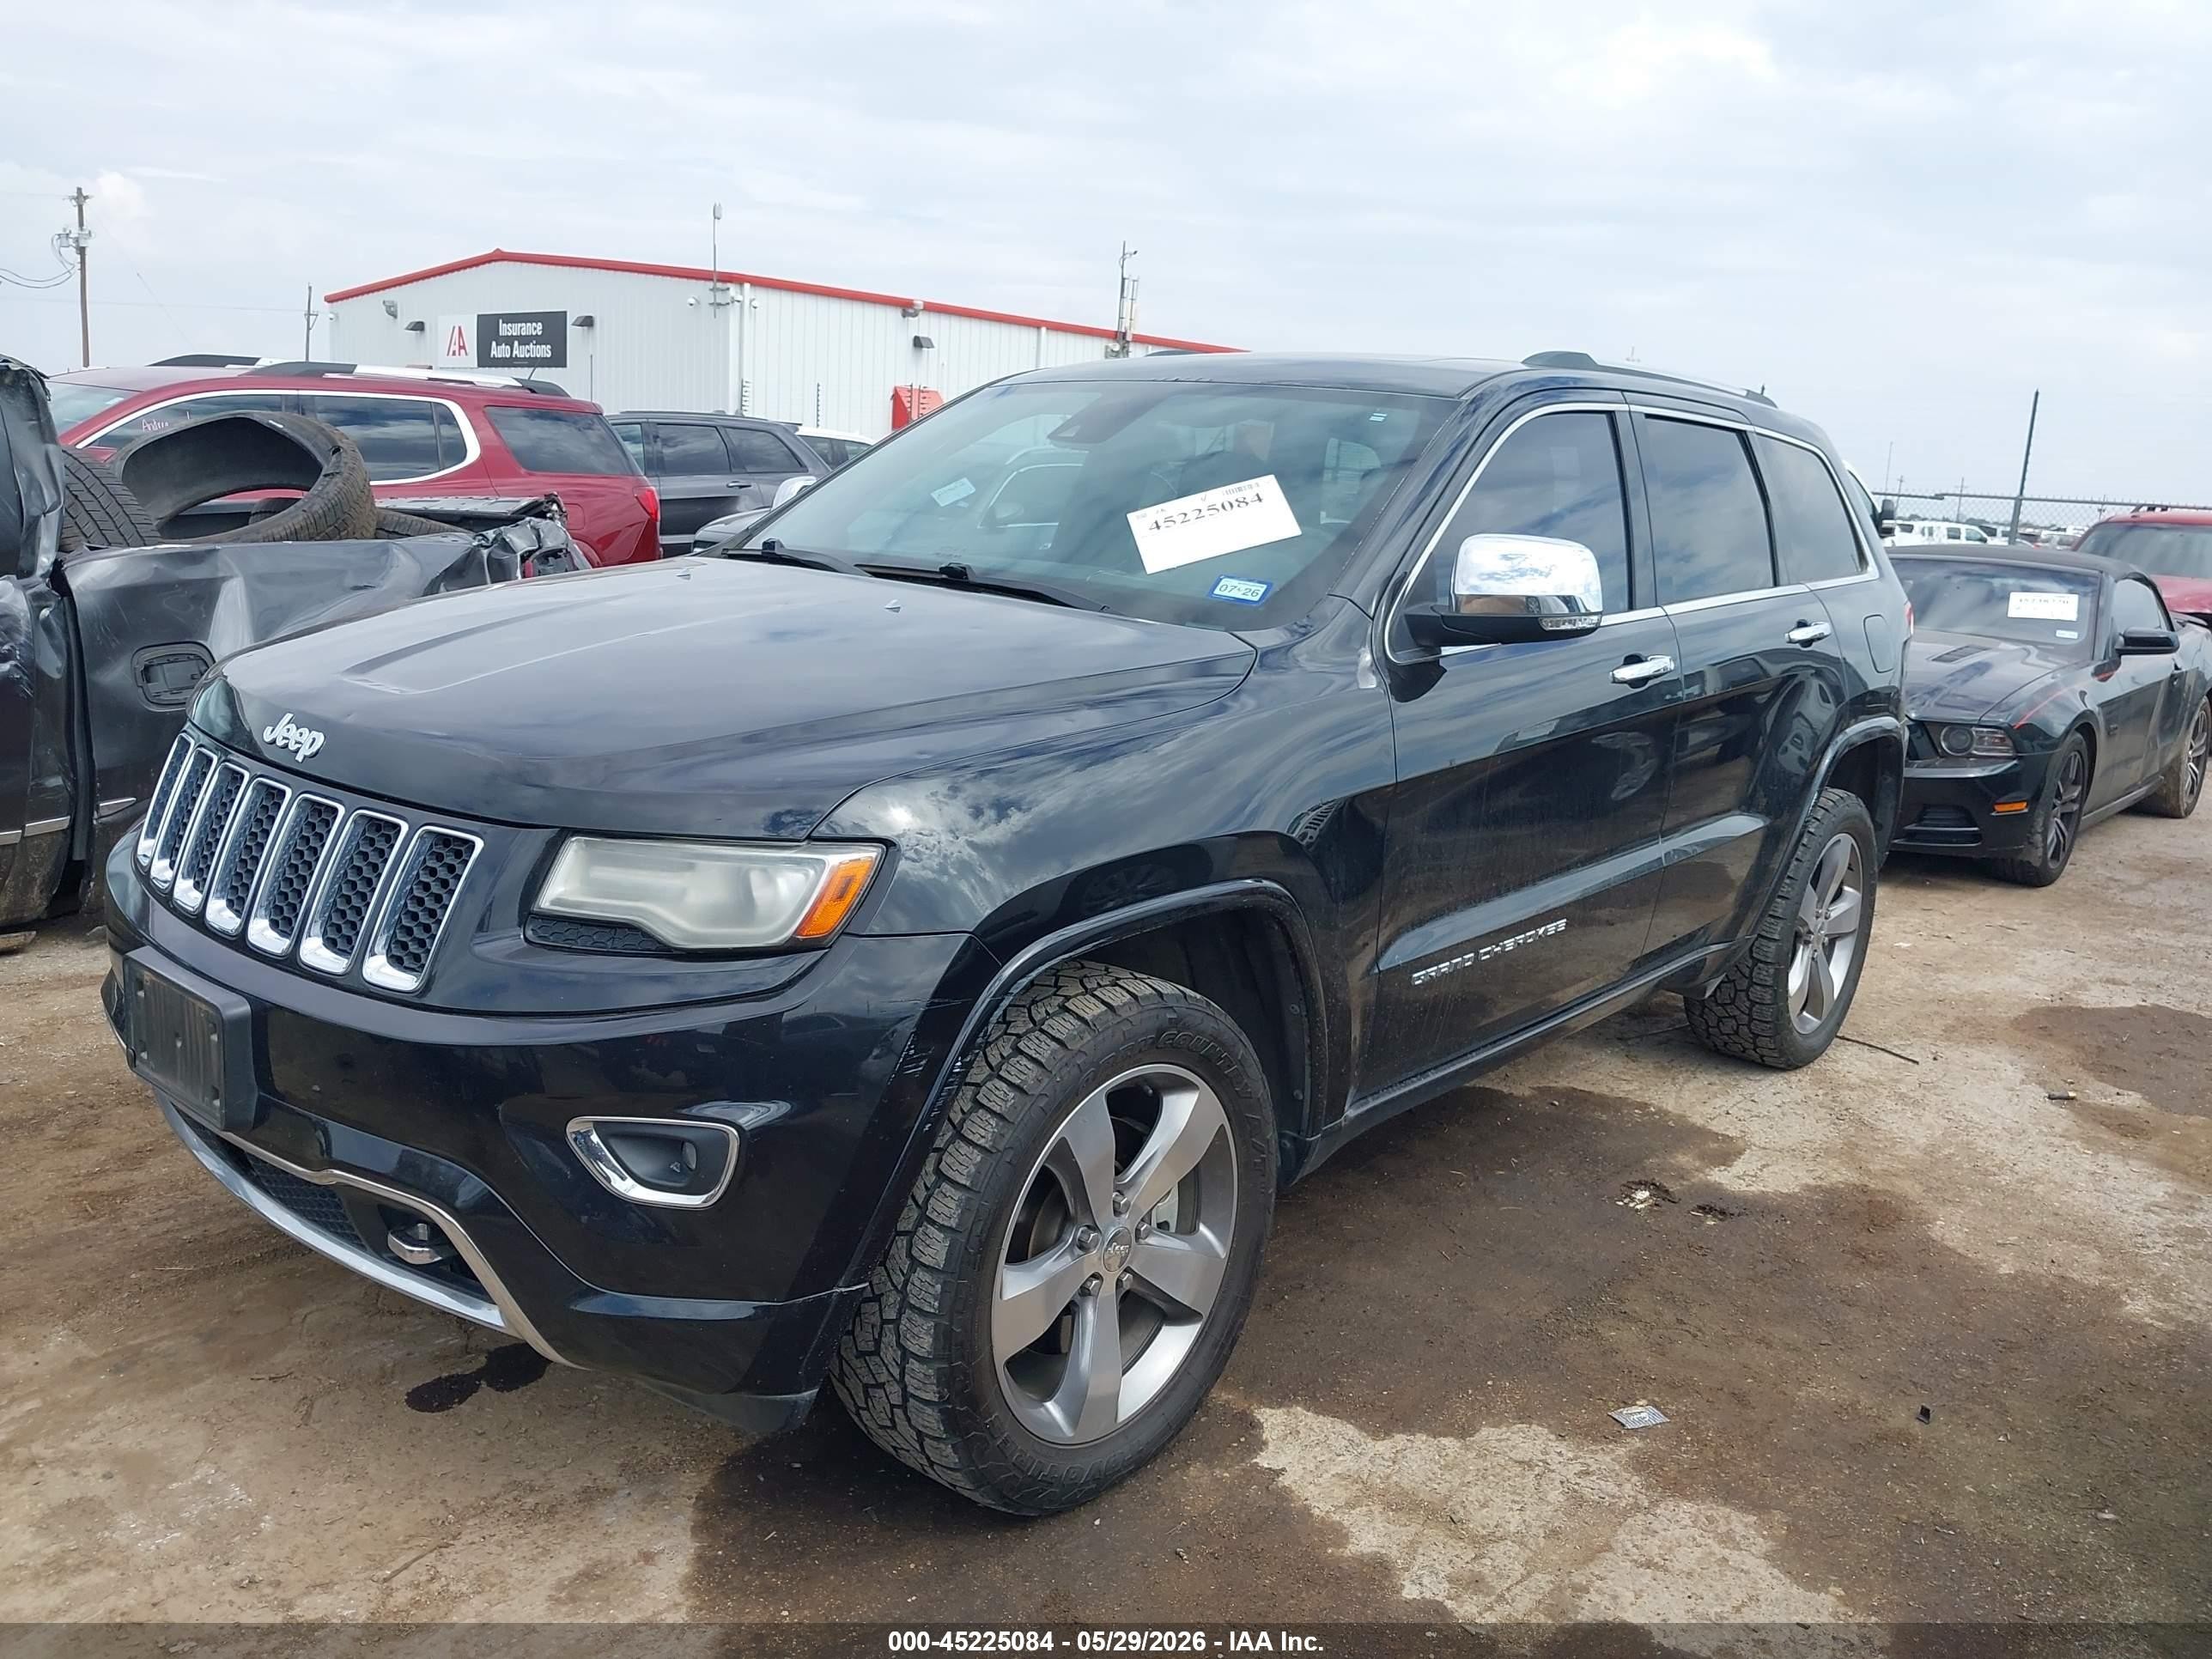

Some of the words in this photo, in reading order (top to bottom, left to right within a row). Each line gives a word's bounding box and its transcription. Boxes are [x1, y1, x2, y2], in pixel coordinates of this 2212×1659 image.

[499, 319, 543, 337] Insurance
[490, 341, 510, 358] Auto
[512, 340, 552, 358] Auctions
[1149, 492, 1264, 531] 45225084
[263, 713, 325, 763] Jeep
[1411, 953, 1474, 986] GRAND
[1478, 918, 1567, 961] CHEROKEE
